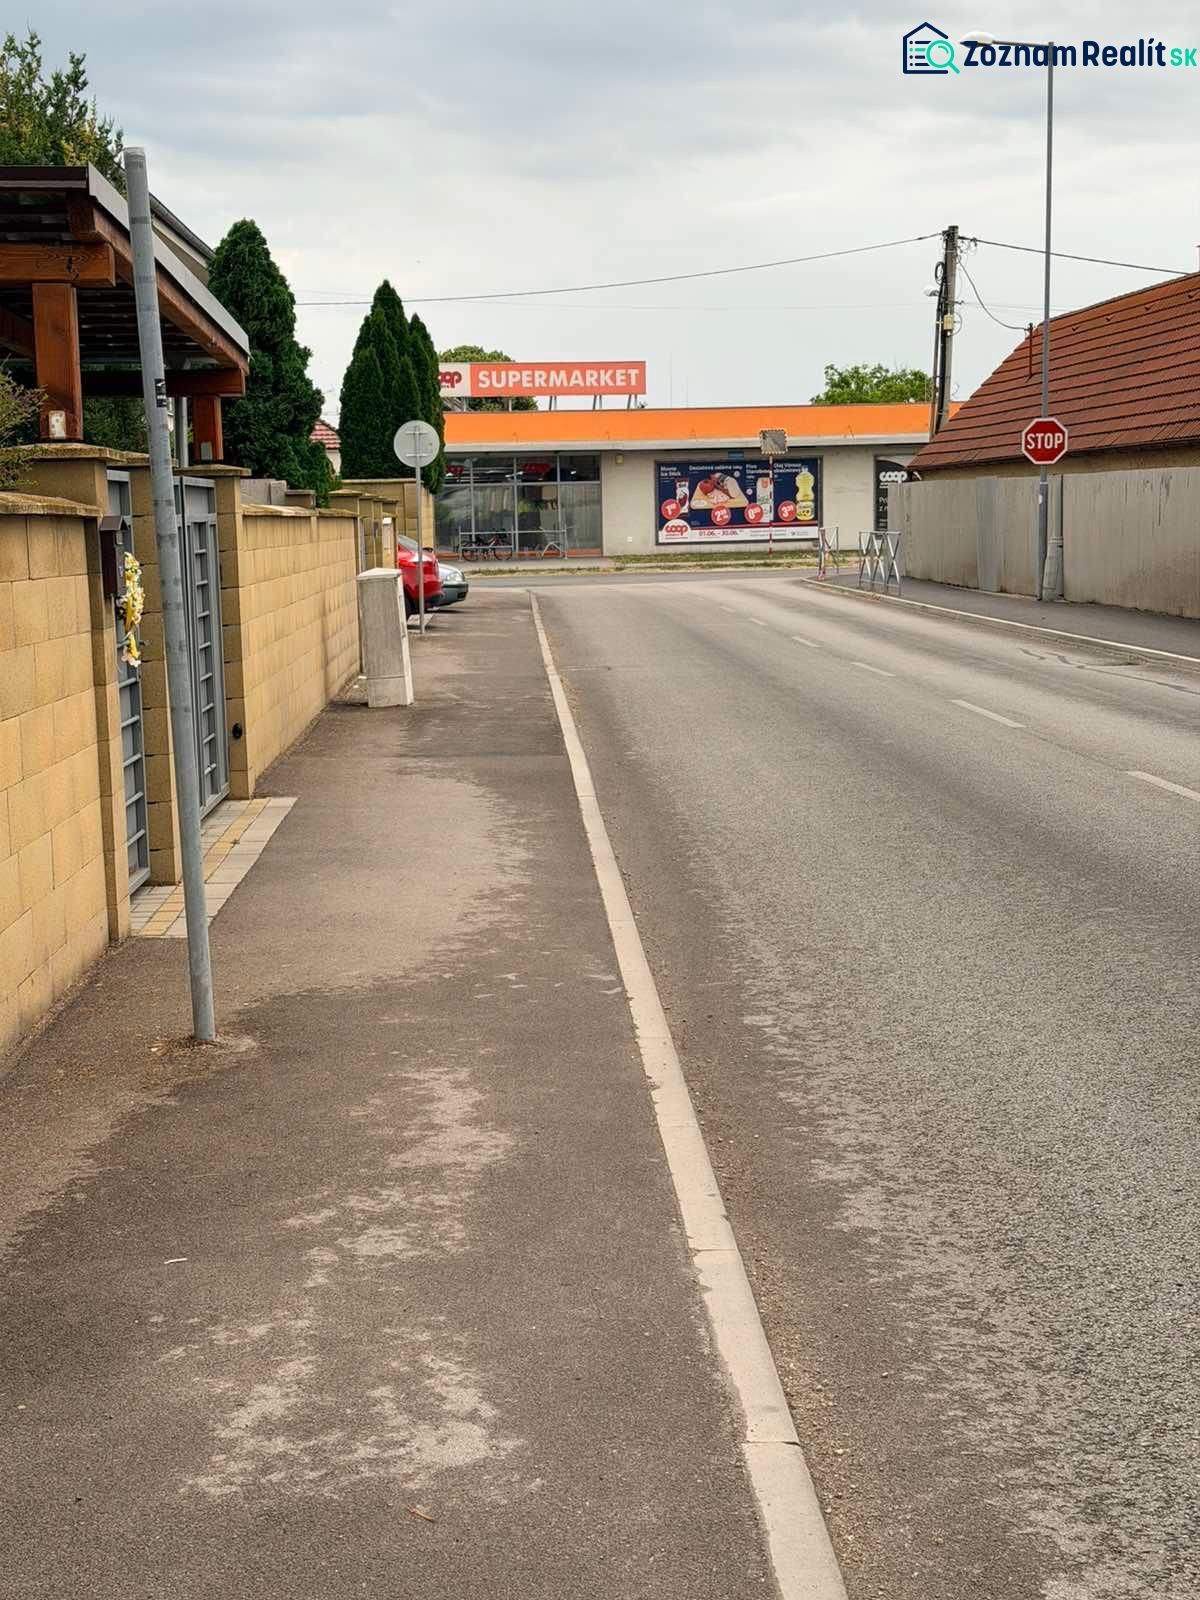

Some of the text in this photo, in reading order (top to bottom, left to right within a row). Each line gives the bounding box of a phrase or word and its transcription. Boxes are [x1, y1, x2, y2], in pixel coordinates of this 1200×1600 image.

[438, 371, 463, 388] oop
[478, 368, 640, 388] SUPERMARKET
[1026, 432, 1064, 449] STOP
[880, 471, 908, 484] coop
[665, 525, 688, 537] coop
